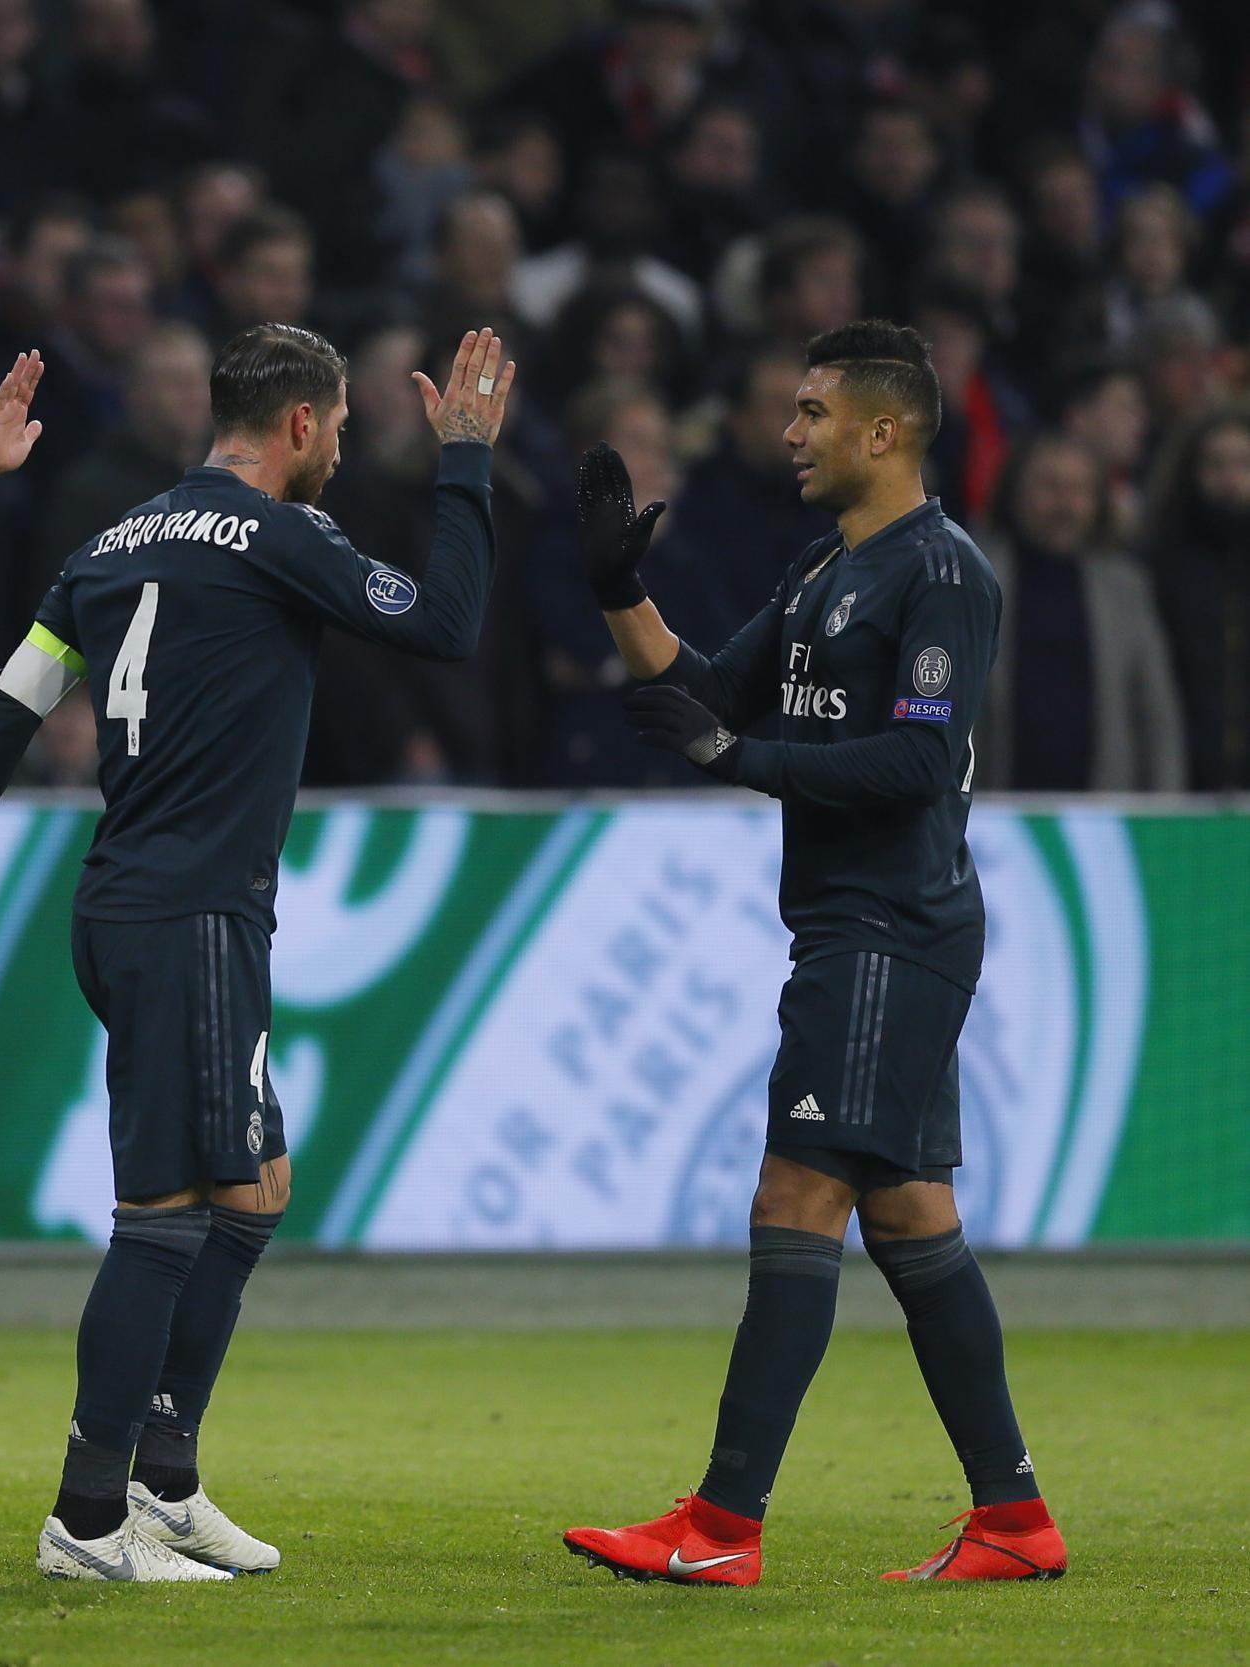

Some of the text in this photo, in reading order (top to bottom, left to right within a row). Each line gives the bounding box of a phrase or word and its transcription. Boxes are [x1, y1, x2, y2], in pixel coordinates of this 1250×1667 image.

[90, 510, 259, 557] SERGIO RAMOS
[106, 582, 159, 756] 4
[923, 671, 939, 683] 13
[546, 847, 721, 1088] PARIS
[250, 1031, 268, 1103] 4
[570, 967, 743, 1203] PARIS
[790, 1109, 825, 1121] adidas
